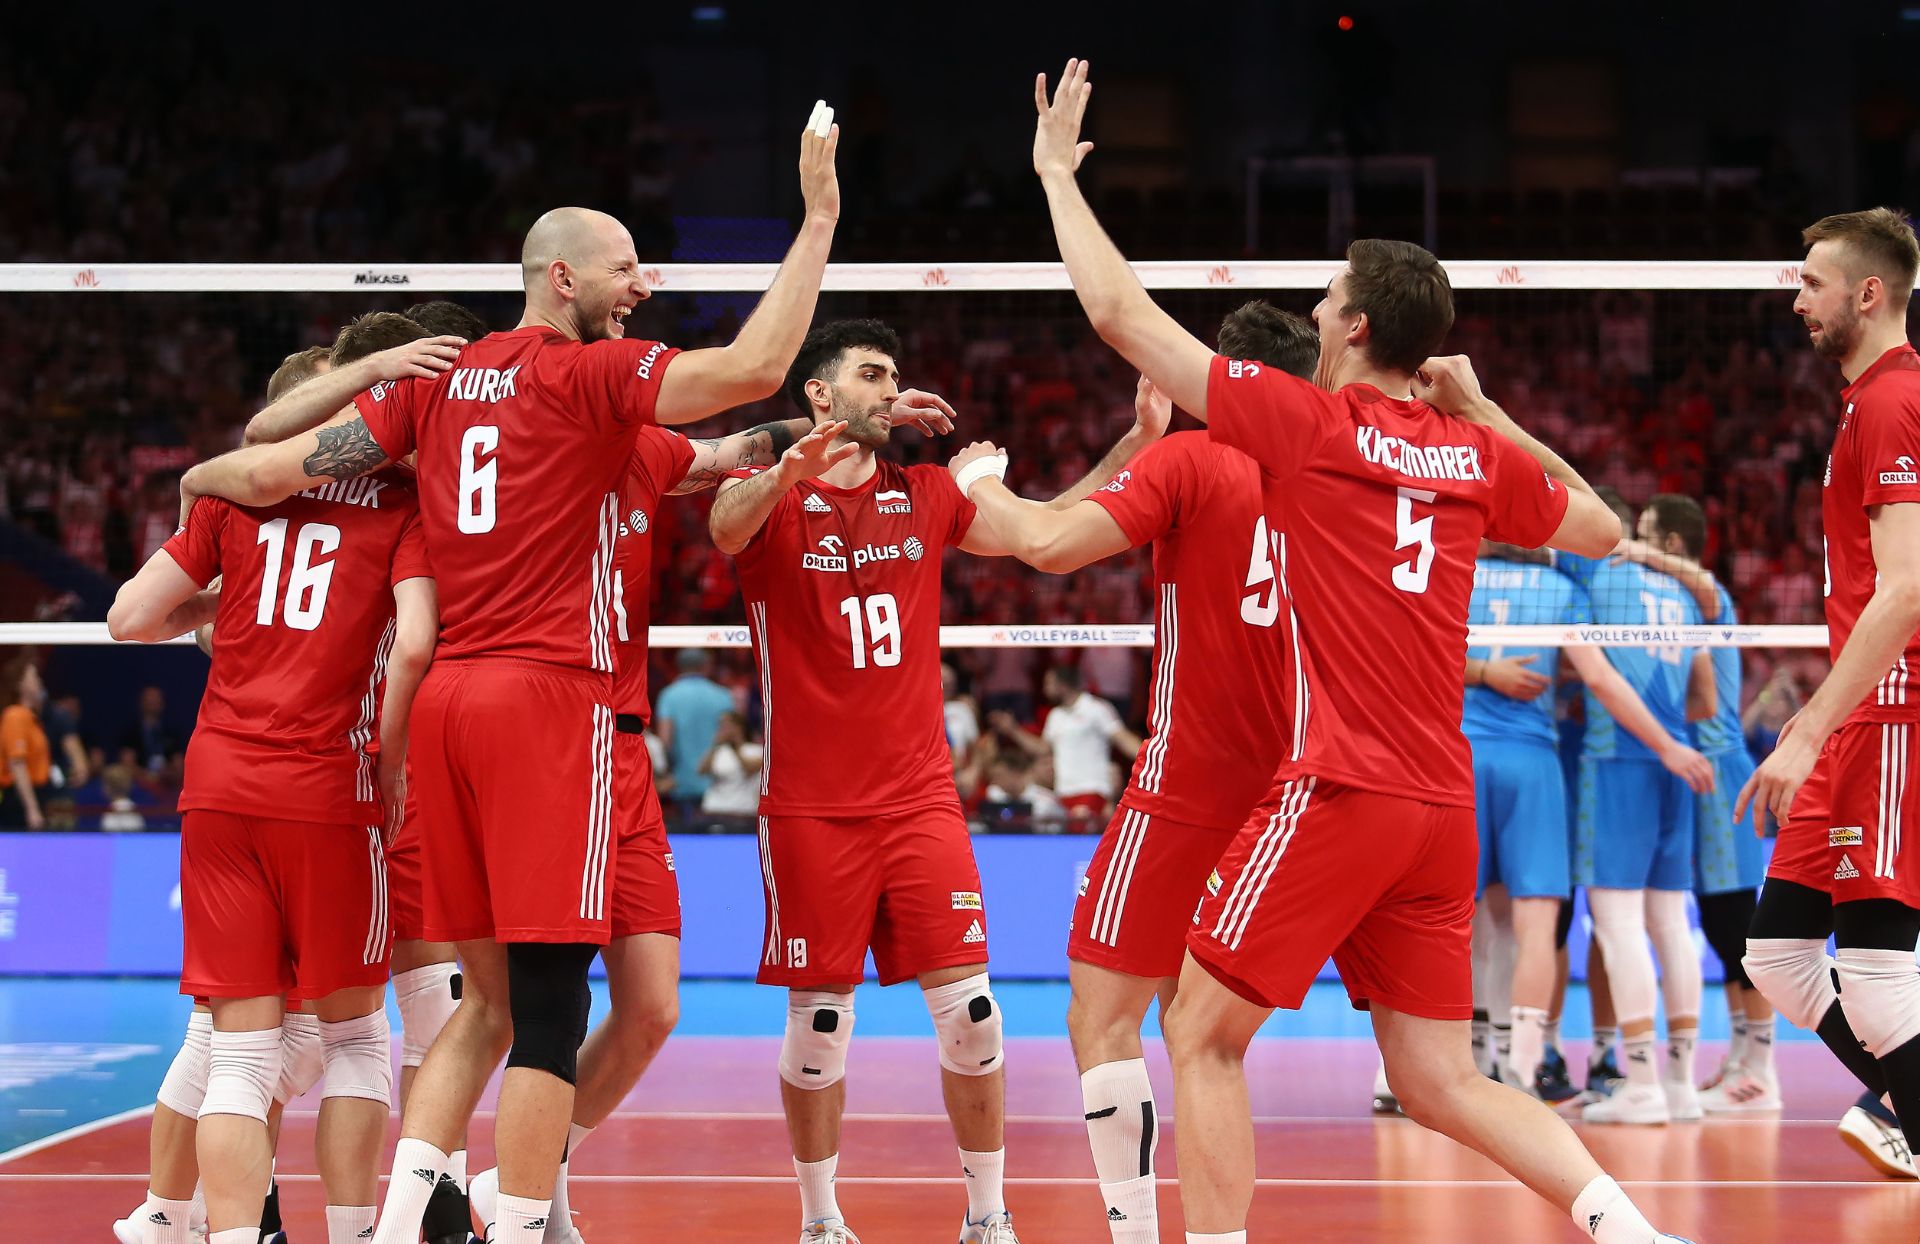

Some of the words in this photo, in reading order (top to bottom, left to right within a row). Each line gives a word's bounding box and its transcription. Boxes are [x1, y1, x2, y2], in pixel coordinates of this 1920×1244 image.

[447, 364, 522, 404] KUREK
[457, 425, 500, 535] 6
[1882, 473, 1915, 482] ORLEN
[878, 505, 912, 515] POLSKA
[1391, 486, 1438, 594] 5
[805, 555, 845, 570] ORLEN
[853, 543, 901, 569] plus
[256, 517, 341, 631] 16
[840, 592, 902, 669] 19
[1009, 630, 1108, 641] VOLLEYBALL
[1581, 630, 1679, 641] VOLLEYBALL
[1833, 869, 1860, 880] adidas
[787, 937, 807, 968] 19
